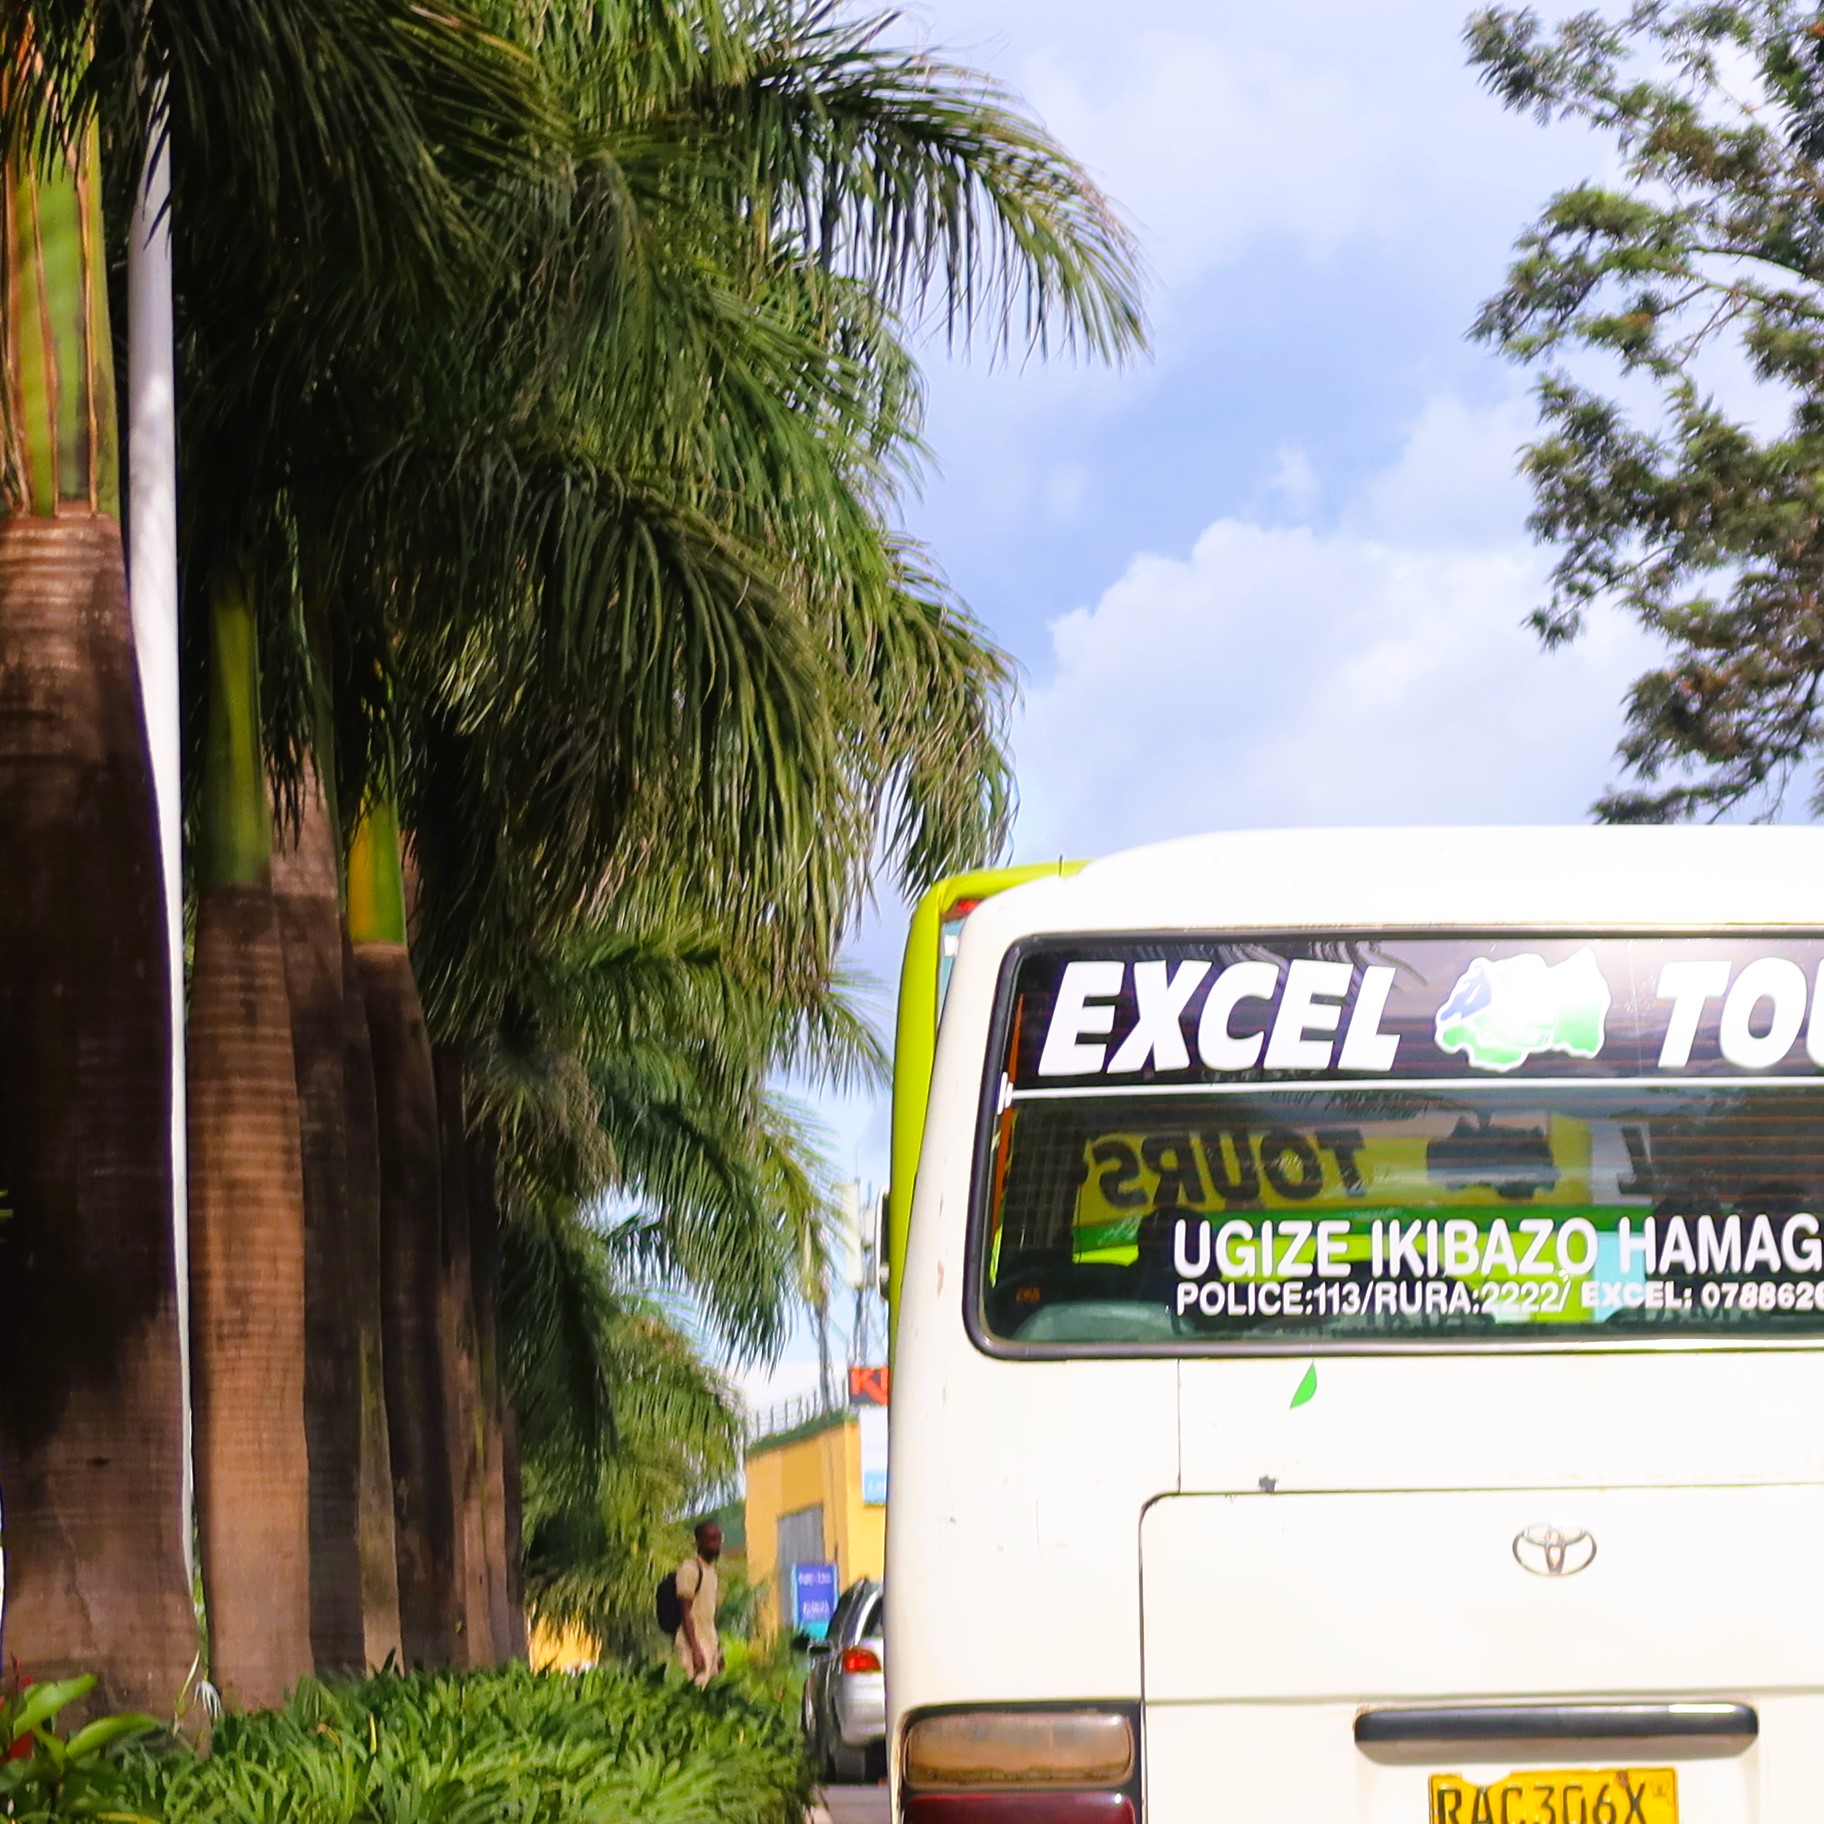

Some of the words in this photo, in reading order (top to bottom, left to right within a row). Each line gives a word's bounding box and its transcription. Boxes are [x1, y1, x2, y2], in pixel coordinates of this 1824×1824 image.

[1038, 959, 1401, 1076] EXCEL
[1174, 1218, 1352, 1279] UGIZE
[1371, 1217, 1599, 1278] IKIBAZO
[1581, 1280, 1692, 1309] EXCEL:
